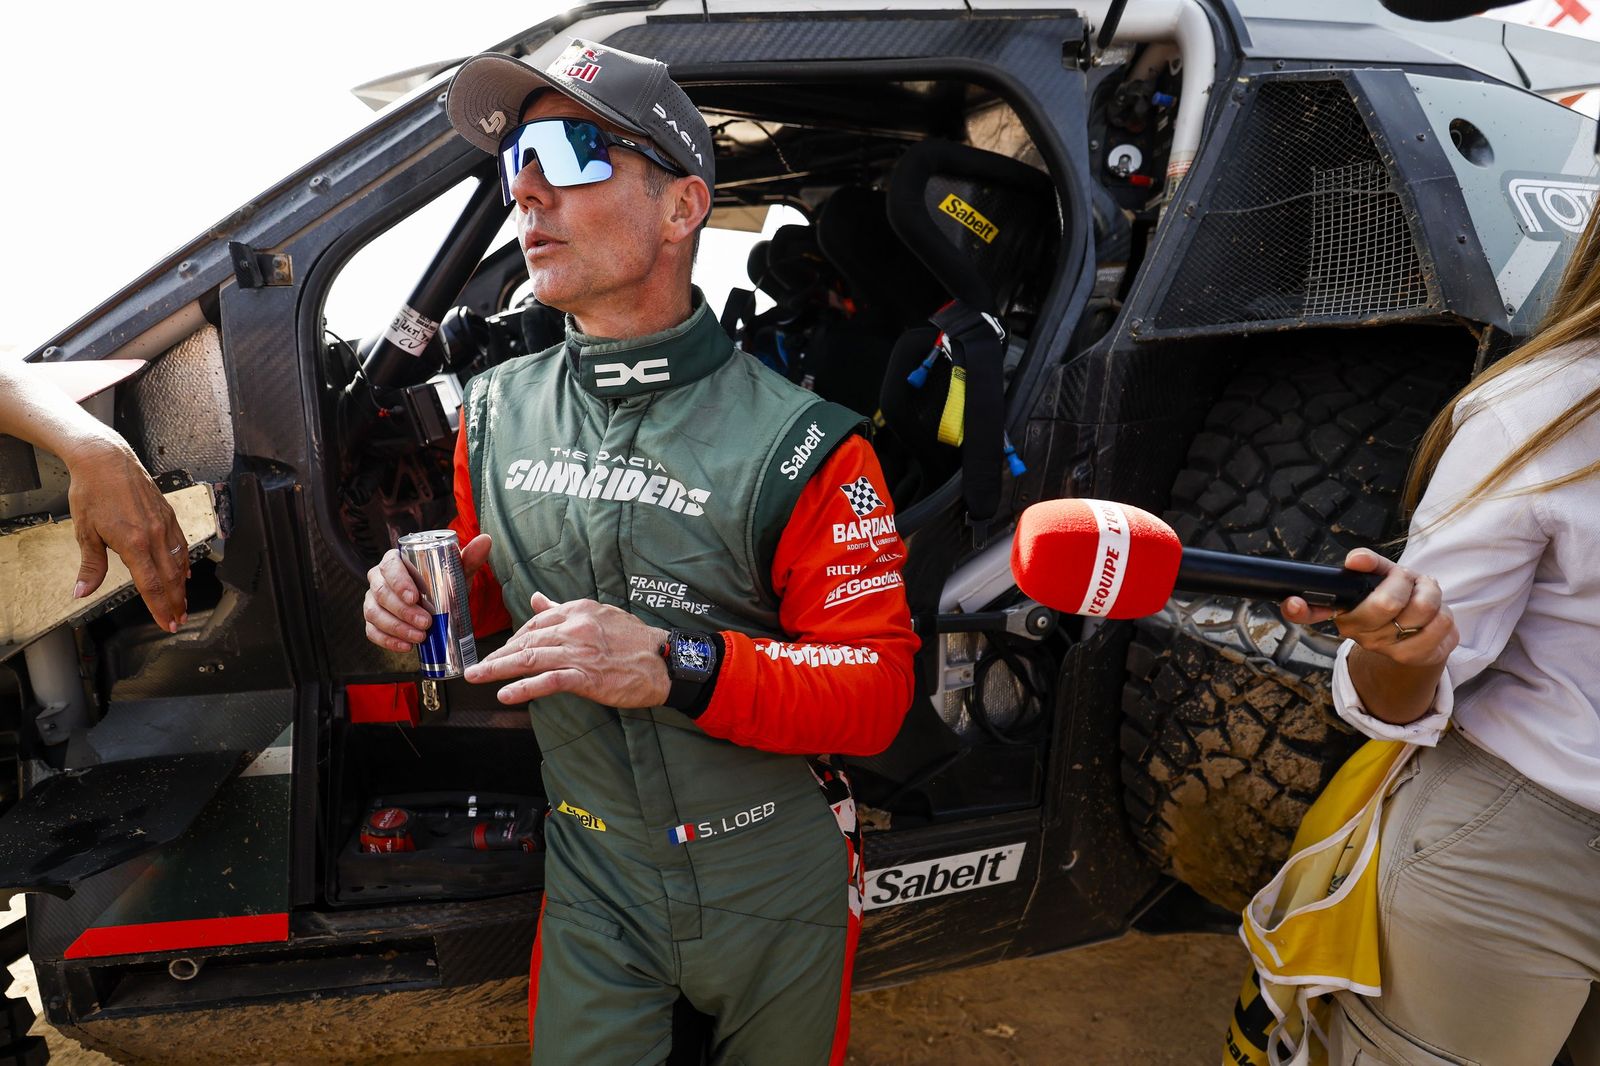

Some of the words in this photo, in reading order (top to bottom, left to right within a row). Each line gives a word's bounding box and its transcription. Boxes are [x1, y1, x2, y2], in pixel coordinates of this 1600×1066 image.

[652, 103, 703, 168] DACIA
[945, 199, 994, 240] Sabelt
[550, 447, 588, 461] THE
[596, 450, 668, 473] DACIA
[780, 421, 825, 481] Sabelt
[504, 459, 712, 517] SANDRIDERS
[629, 576, 688, 596] FRANCE
[629, 588, 711, 615] PRE-BRISE
[697, 822, 719, 838] S.
[721, 801, 776, 833] LOEB
[871, 851, 1007, 905] Sabelt
